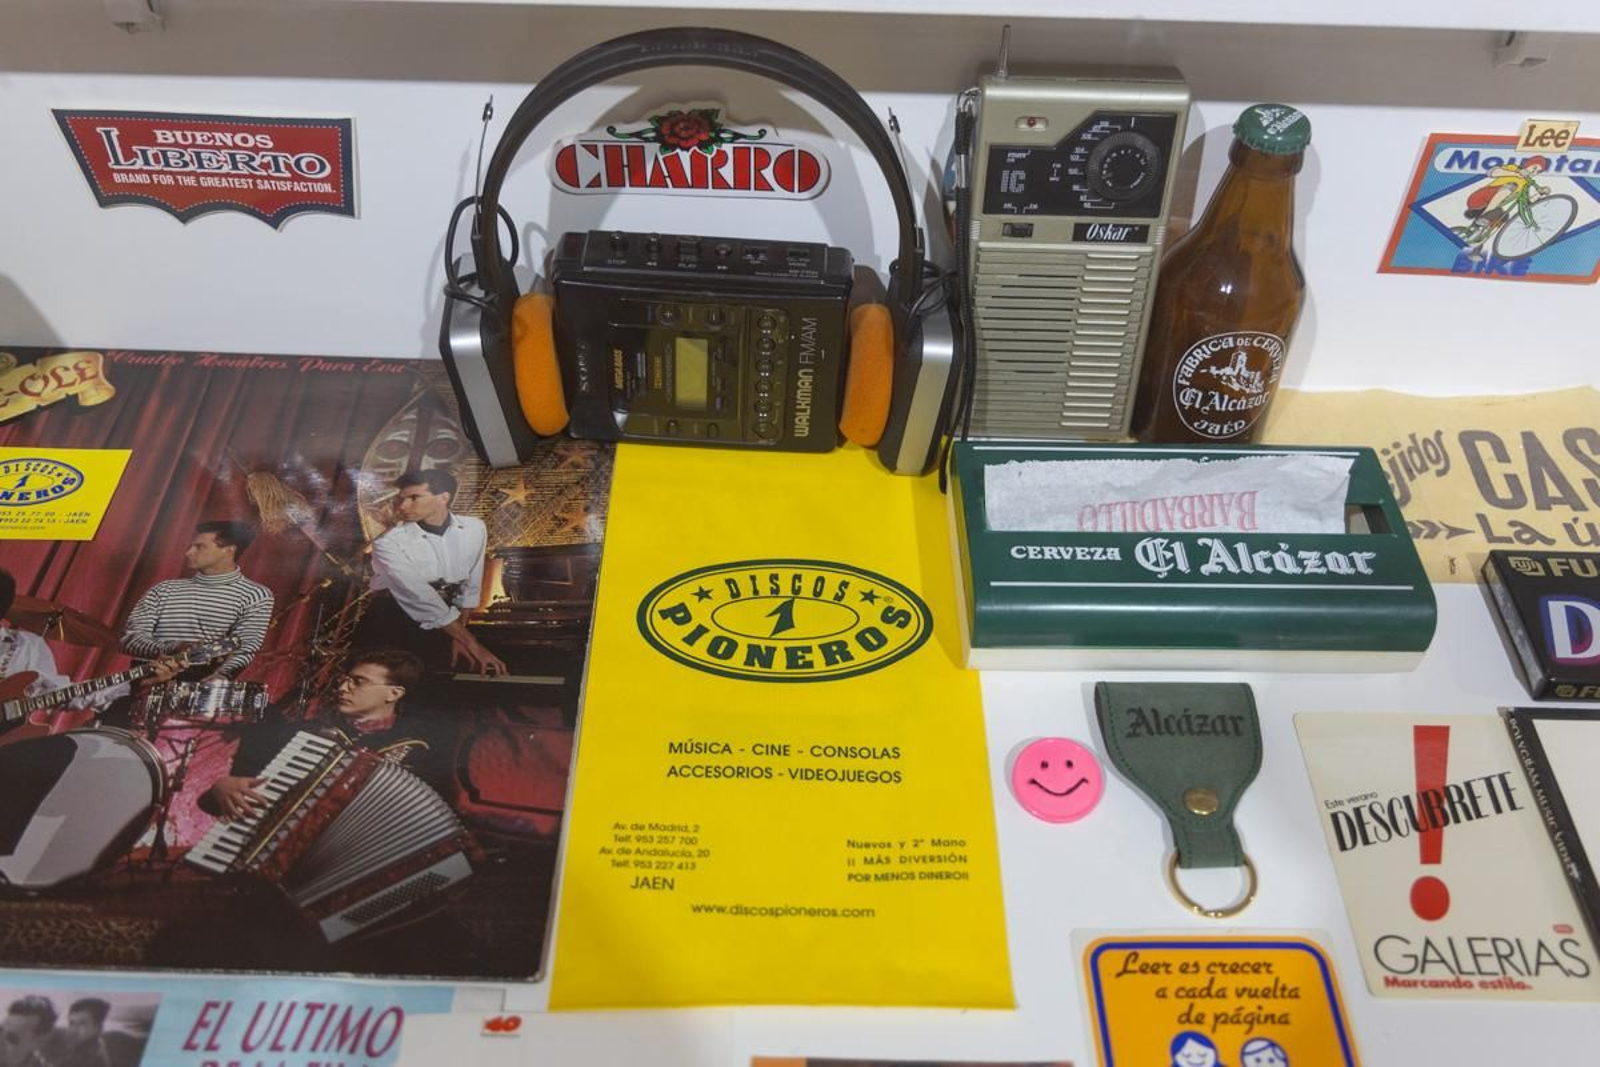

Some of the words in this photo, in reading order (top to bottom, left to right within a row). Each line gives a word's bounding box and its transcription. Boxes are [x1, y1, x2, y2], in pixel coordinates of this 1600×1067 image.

[154, 130, 274, 147] BUENOS
[1522, 124, 1570, 148] Lee
[97, 127, 331, 178] LIBERTO
[1444, 150, 1600, 174] Mota
[555, 144, 821, 193] CHARRO
[113, 173, 151, 185] BRAND
[153, 174, 175, 186] FOR
[177, 175, 198, 187] THE
[200, 177, 254, 189] GREATEST
[256, 179, 336, 193] SATISFACTION.
[1085, 224, 1131, 241] Oskar
[1236, 337, 1252, 347] DE
[794, 368, 815, 437] WALKMAN
[1179, 387, 1203, 410] El
[1382, 429, 1451, 508] jidos
[1475, 512, 1556, 546] La
[1010, 545, 1122, 562] CERVEZA
[1134, 537, 1190, 579] El
[1198, 537, 1377, 577] Alcázar
[725, 573, 850, 603] DISCOS
[658, 601, 912, 669] PIONEROS
[1125, 706, 1244, 739] Alcázar
[668, 739, 732, 755] MÚSICA
[752, 743, 790, 757] CINE
[810, 745, 901, 760] CONSOLAS
[667, 765, 773, 780] ACCESORIOS
[788, 767, 902, 784] VIDEOJUEGOS
[1324, 797, 1344, 810] Este
[1346, 791, 1378, 807] verano
[1331, 771, 1525, 853] DESCUBRETE
[630, 823, 646, 831] de
[693, 825, 700, 833] 2
[616, 847, 632, 855] de
[697, 848, 710, 857] 20
[846, 839, 892, 849] Nuevos
[898, 841, 906, 849] y
[931, 838, 966, 848] Mano
[863, 855, 892, 865] MÁS
[899, 852, 968, 864] DIVERSIÓN
[630, 876, 675, 891] JAEN
[847, 872, 871, 882] POR
[874, 871, 916, 881] MENOS
[691, 902, 876, 919] www.discospioneros.com
[1115, 951, 1172, 978] Leer
[1179, 962, 1200, 975] es
[1206, 960, 1273, 975] crecer
[1373, 935, 1590, 978] GALERIAS
[1155, 988, 1168, 999] a
[1175, 978, 1227, 999] cada
[1235, 978, 1301, 999] vuelta
[1384, 975, 1472, 990] Marcando
[182, 1001, 233, 1051] EL
[241, 1001, 405, 1058] ULTIMO
[1177, 1004, 1206, 1025] de
[1212, 1005, 1291, 1034] página
